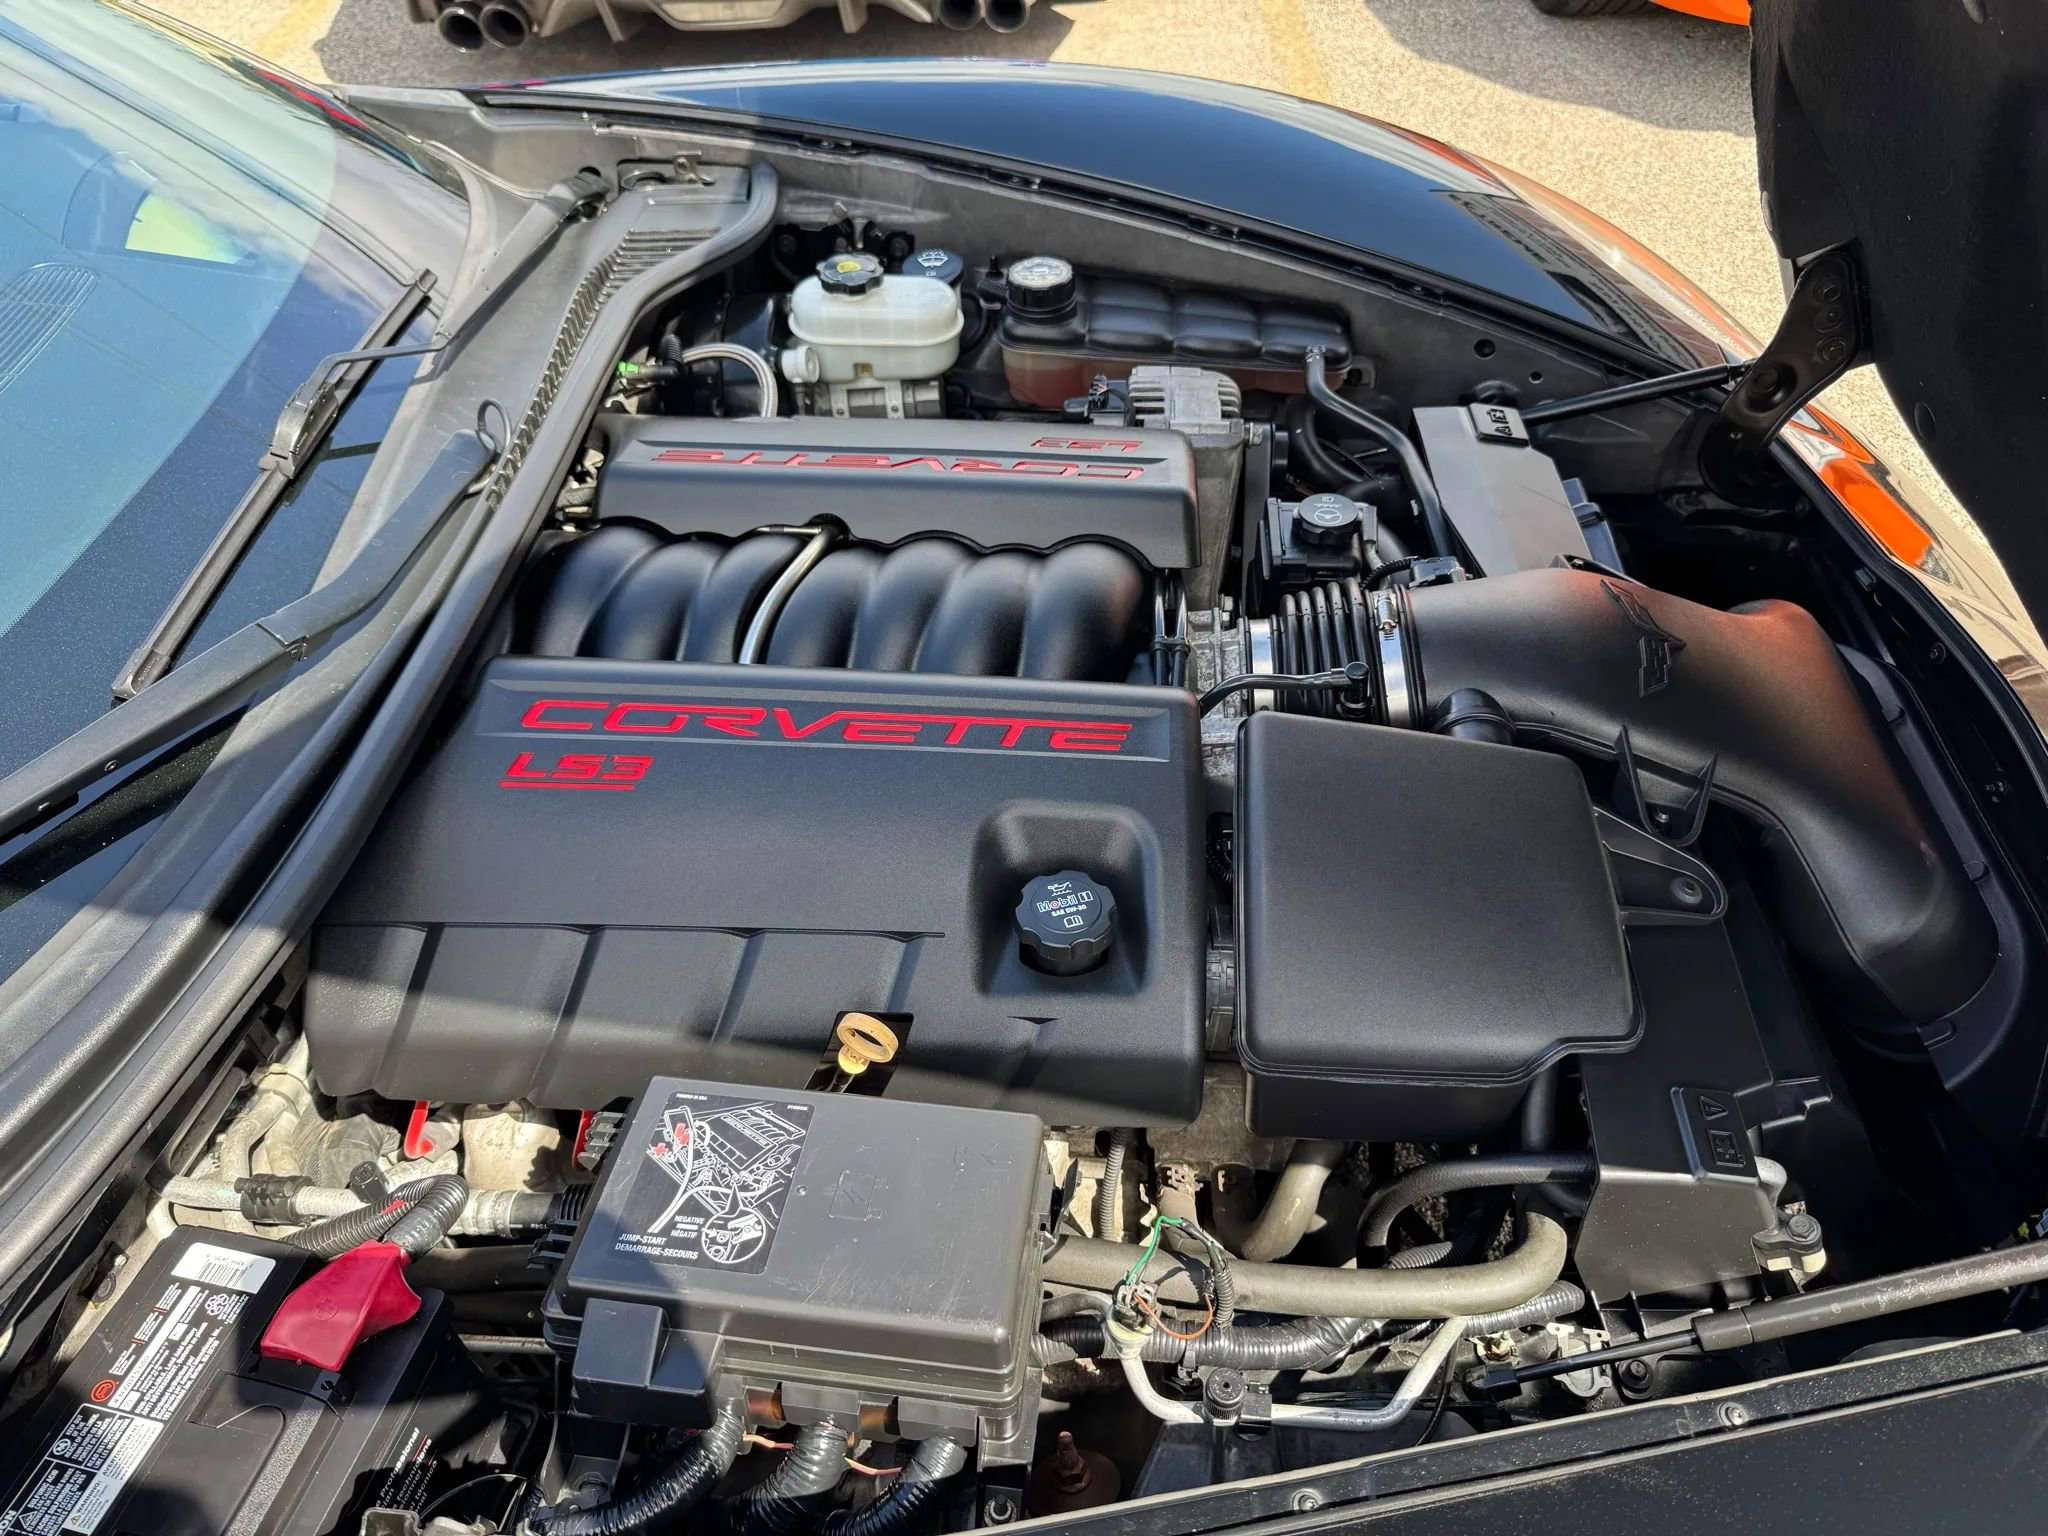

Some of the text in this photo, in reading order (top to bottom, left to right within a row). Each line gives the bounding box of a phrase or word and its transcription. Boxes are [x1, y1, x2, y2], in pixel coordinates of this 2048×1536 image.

[1031, 437, 1143, 453] LS3
[649, 449, 1145, 480] CORVETTE
[521, 699, 1133, 752] CORVETTE
[503, 752, 655, 786] LS3
[1037, 894, 1078, 912] Mobil
[674, 1215, 705, 1224] NEGATIVE
[618, 1233, 667, 1245] JUMP-START
[614, 1243, 699, 1260] DEMARRAGE-SECOURS
[380, 1427, 420, 1498] Professional
